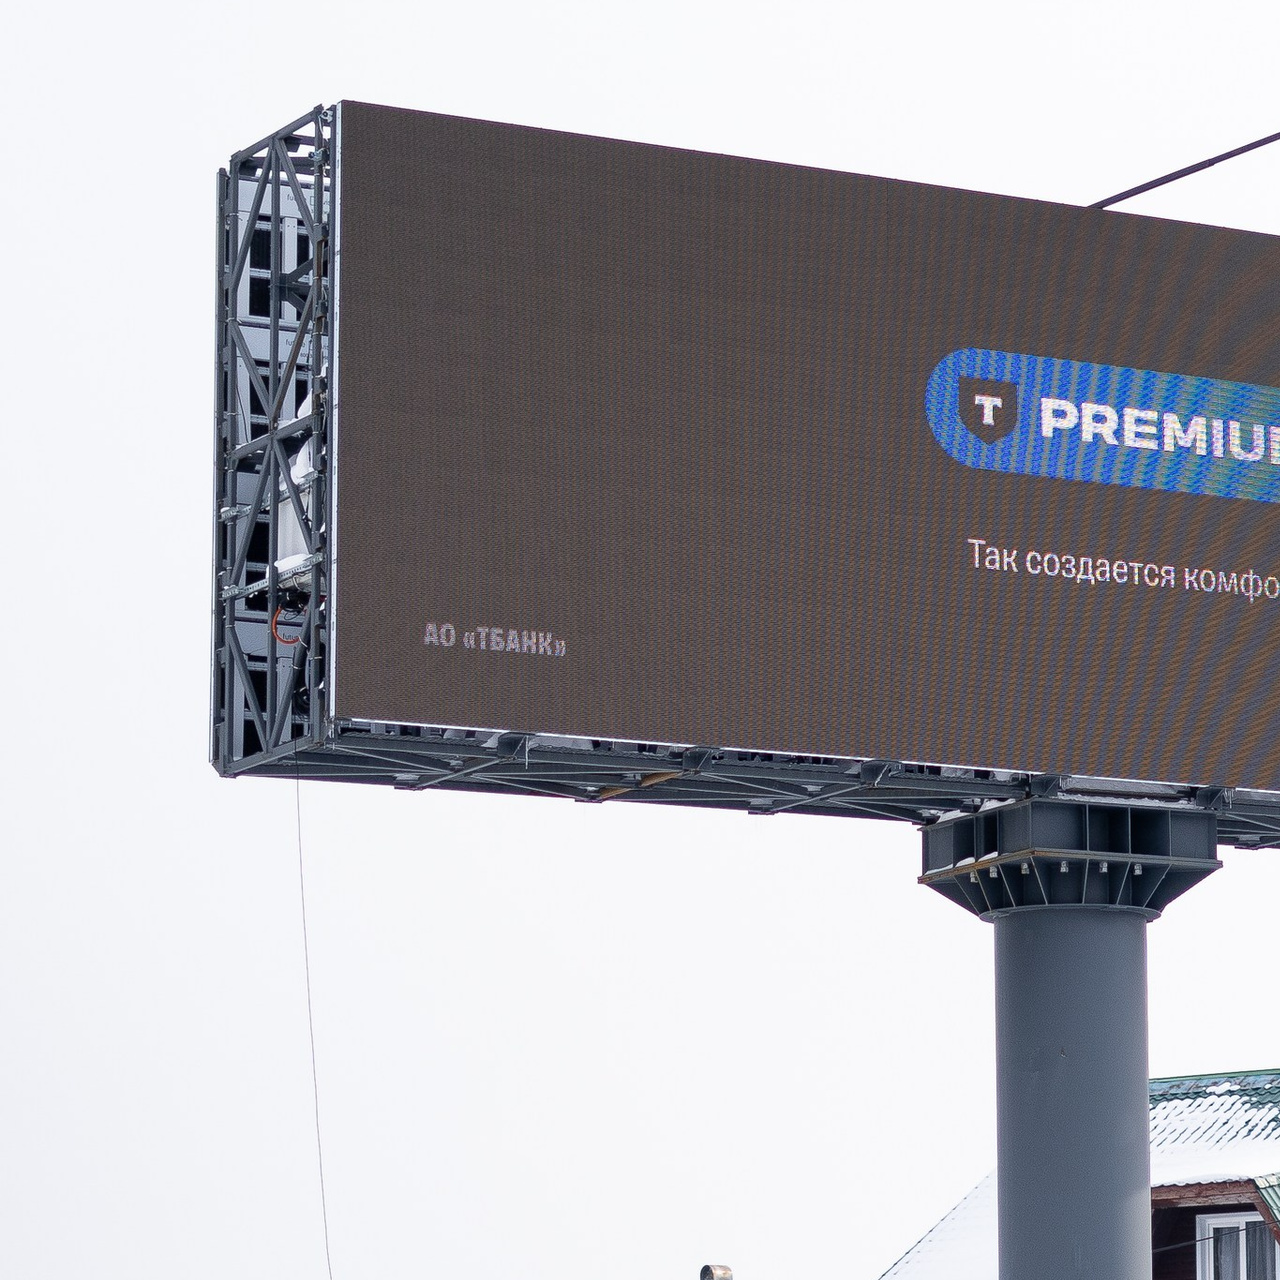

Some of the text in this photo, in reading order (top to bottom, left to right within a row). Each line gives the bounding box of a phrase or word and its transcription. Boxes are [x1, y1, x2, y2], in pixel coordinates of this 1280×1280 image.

[967, 539, 1019, 573] Так
[1025, 549, 1175, 588] создается
[423, 623, 456, 647] АО
